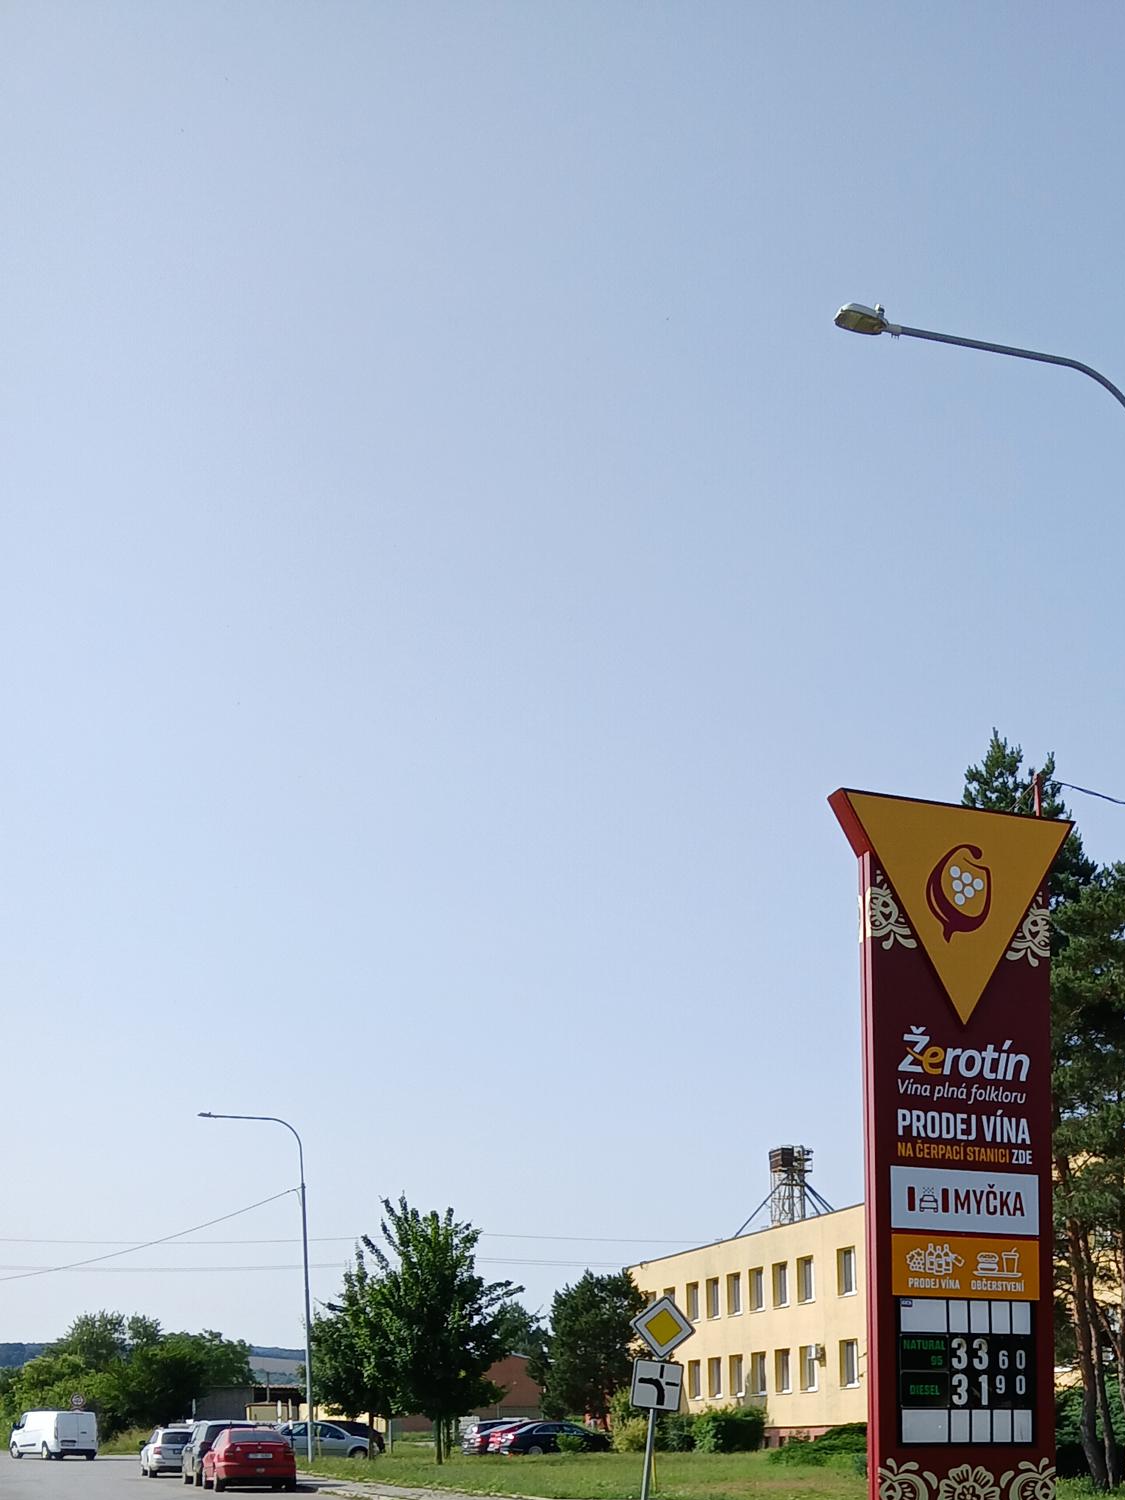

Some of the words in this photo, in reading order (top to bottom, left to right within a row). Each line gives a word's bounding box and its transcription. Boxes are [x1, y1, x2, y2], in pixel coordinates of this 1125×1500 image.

[898, 1025, 1031, 1082] Žerotín
[897, 1079, 930, 1096] Vína
[933, 1082, 967, 1101] plná
[967, 1085, 1027, 1104] folkloru
[897, 1108, 977, 1141] PRODEJ
[981, 1109, 1031, 1145] VÍNA
[897, 1142, 914, 1157] NA
[915, 1139, 965, 1161] ČERPACÍ
[966, 1146, 1010, 1163] STANICI
[1011, 1149, 1033, 1165] ZDE
[953, 1184, 1026, 1217] MYČKA
[908, 1277, 939, 1289] PRODEJ
[941, 1276, 961, 1290] VÍNA
[970, 1278, 1025, 1292] OBČERSTVENÍ
[903, 1339, 946, 1351] NATURAL
[930, 1355, 943, 1366] 95
[909, 1384, 941, 1396] DIESEL
